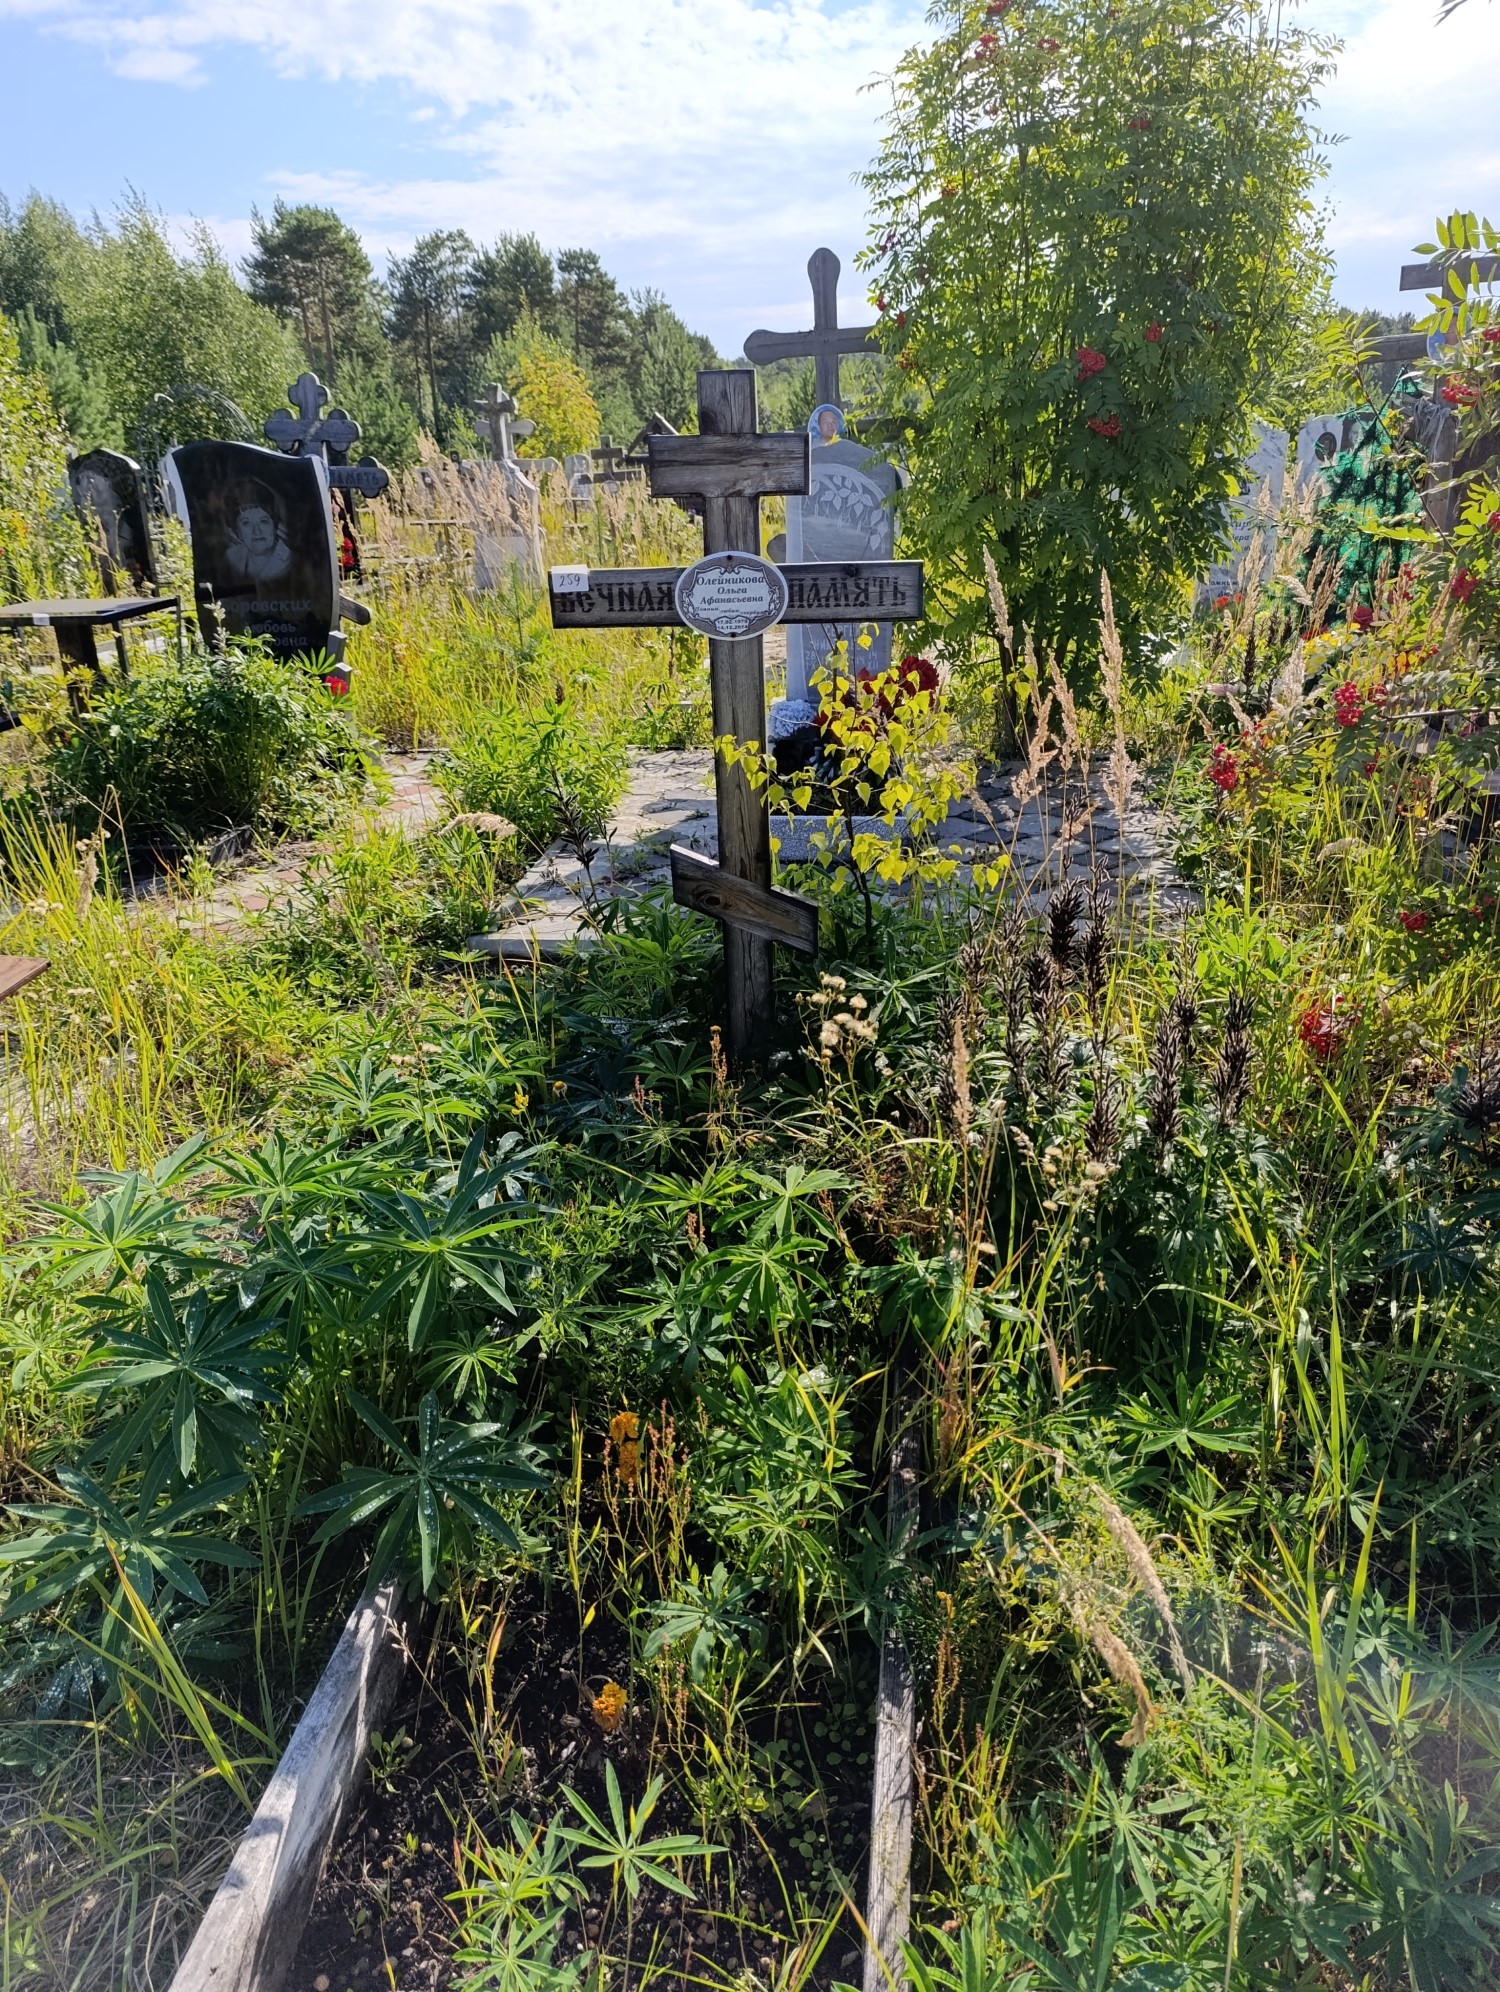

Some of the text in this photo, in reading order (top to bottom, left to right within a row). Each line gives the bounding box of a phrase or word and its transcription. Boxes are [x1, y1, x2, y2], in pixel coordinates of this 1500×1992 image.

[559, 573, 581, 588] 259
[696, 575, 765, 586] Олейникова
[717, 586, 748, 595] Ольга
[787, 576, 906, 608] ПАМЯТЬ
[700, 596, 764, 606] Афанасьевна
[222, 599, 312, 618] оровских
